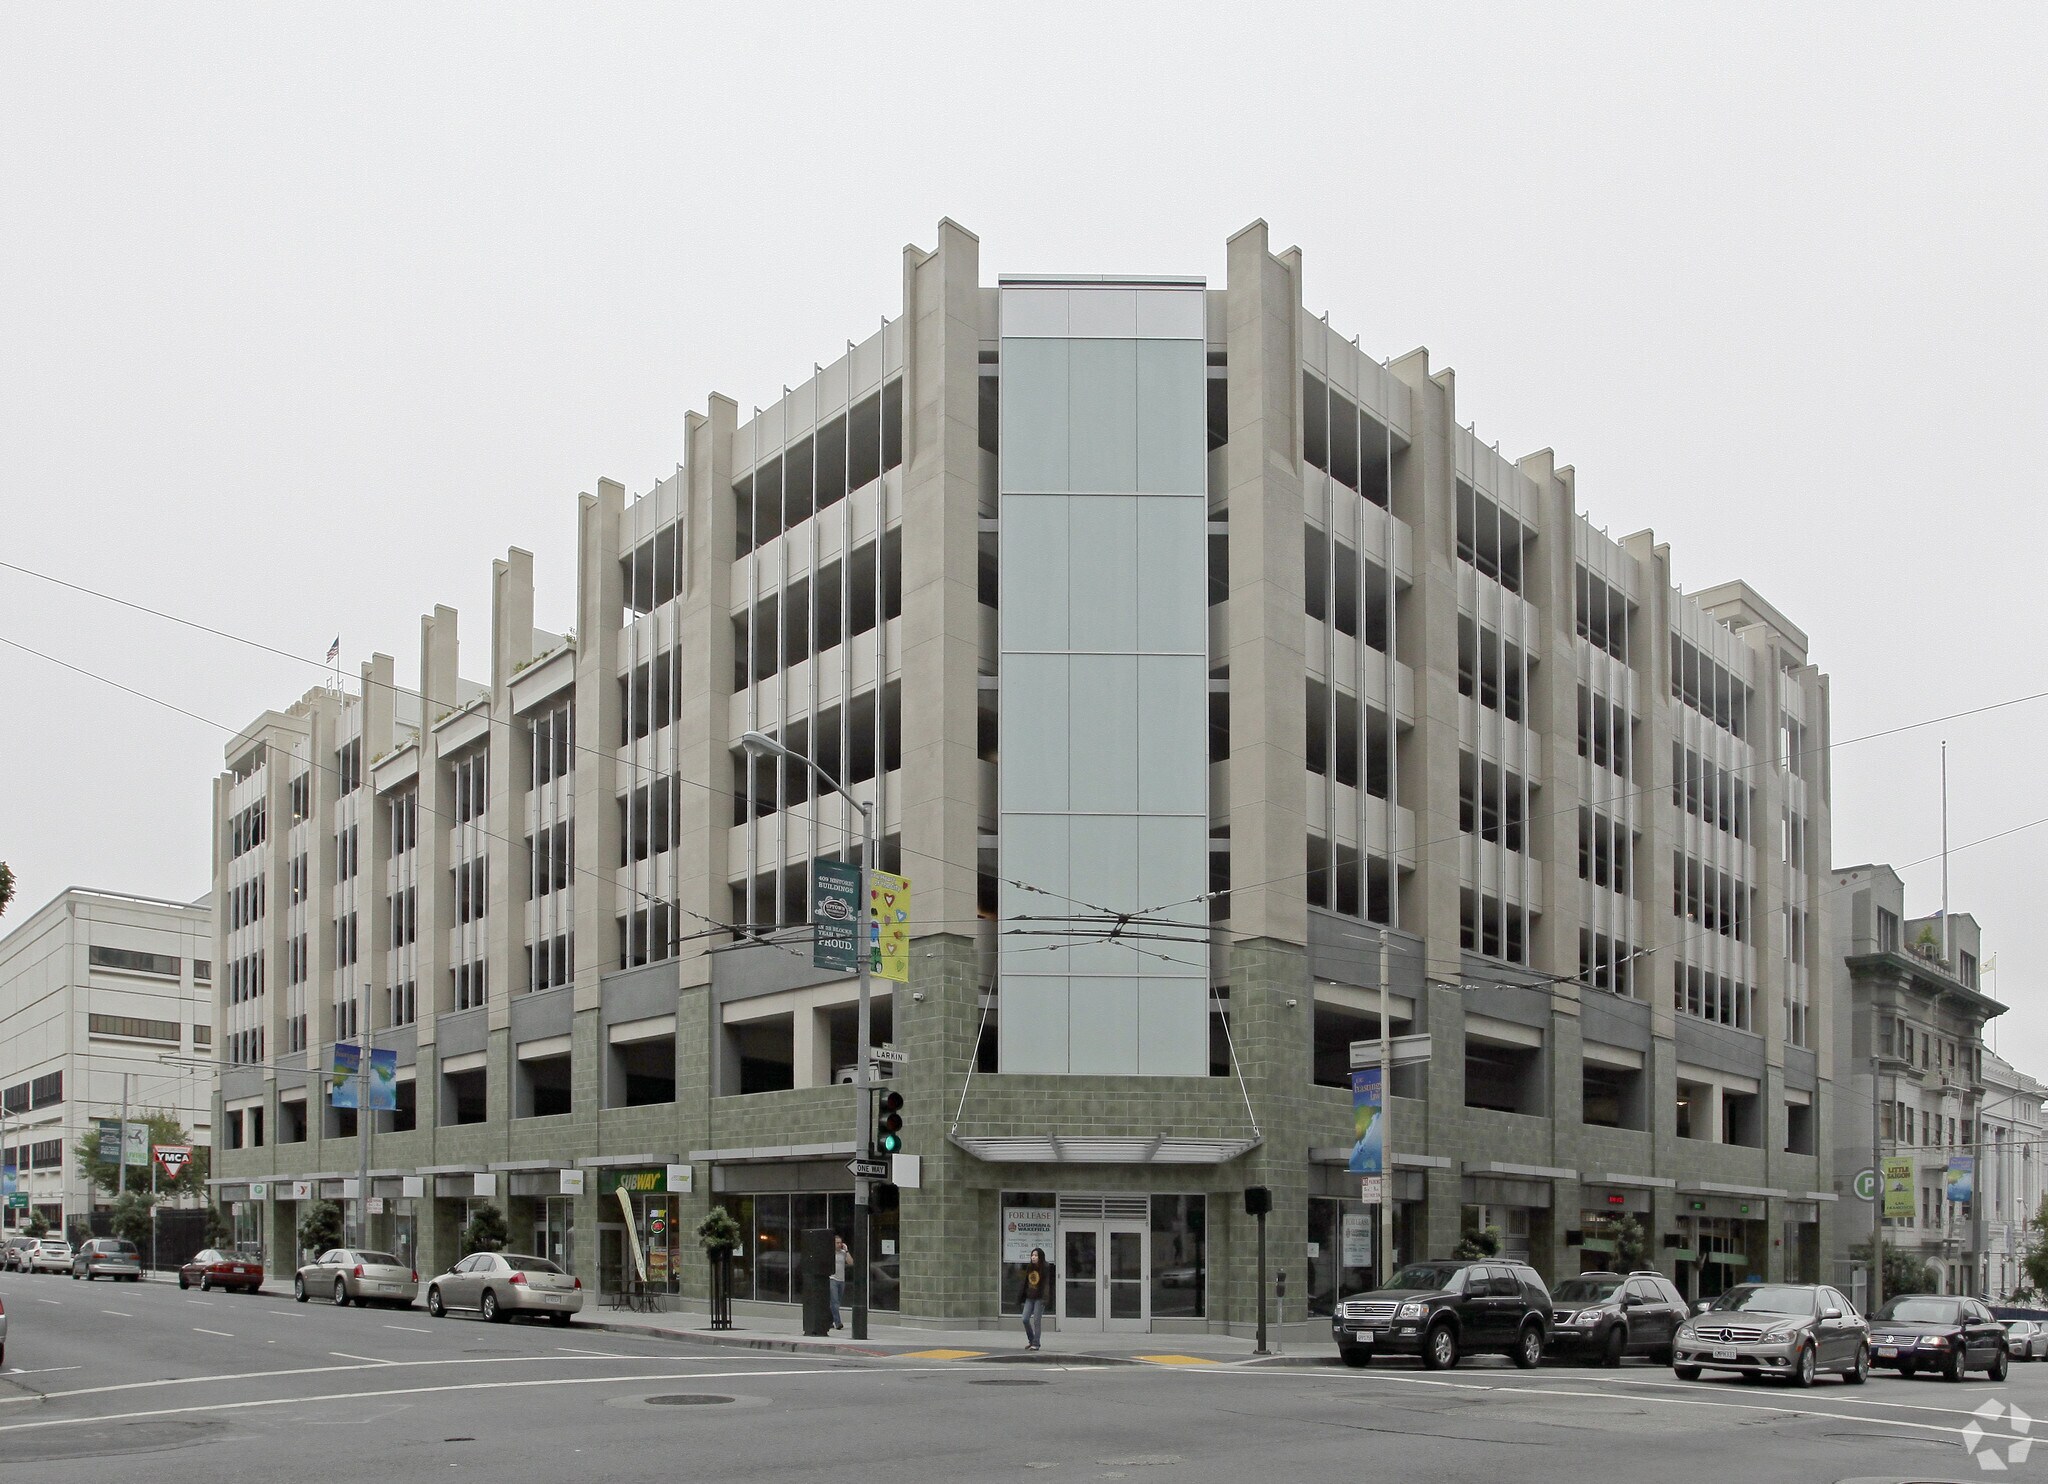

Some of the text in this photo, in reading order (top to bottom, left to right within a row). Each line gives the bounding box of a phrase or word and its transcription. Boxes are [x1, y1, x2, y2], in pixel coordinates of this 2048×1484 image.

[818, 882, 854, 894] BUILDINGS
[876, 1050, 903, 1061] LARKIN
[157, 1153, 190, 1162] YMCA
[857, 1164, 884, 1174] ONE WAY
[1888, 1166, 1910, 1174] LITTLE
[1887, 1172, 1911, 1180] SAIGON
[620, 1173, 661, 1191] SUBWAY
[1008, 1211, 1052, 1220] FOR LEASE
